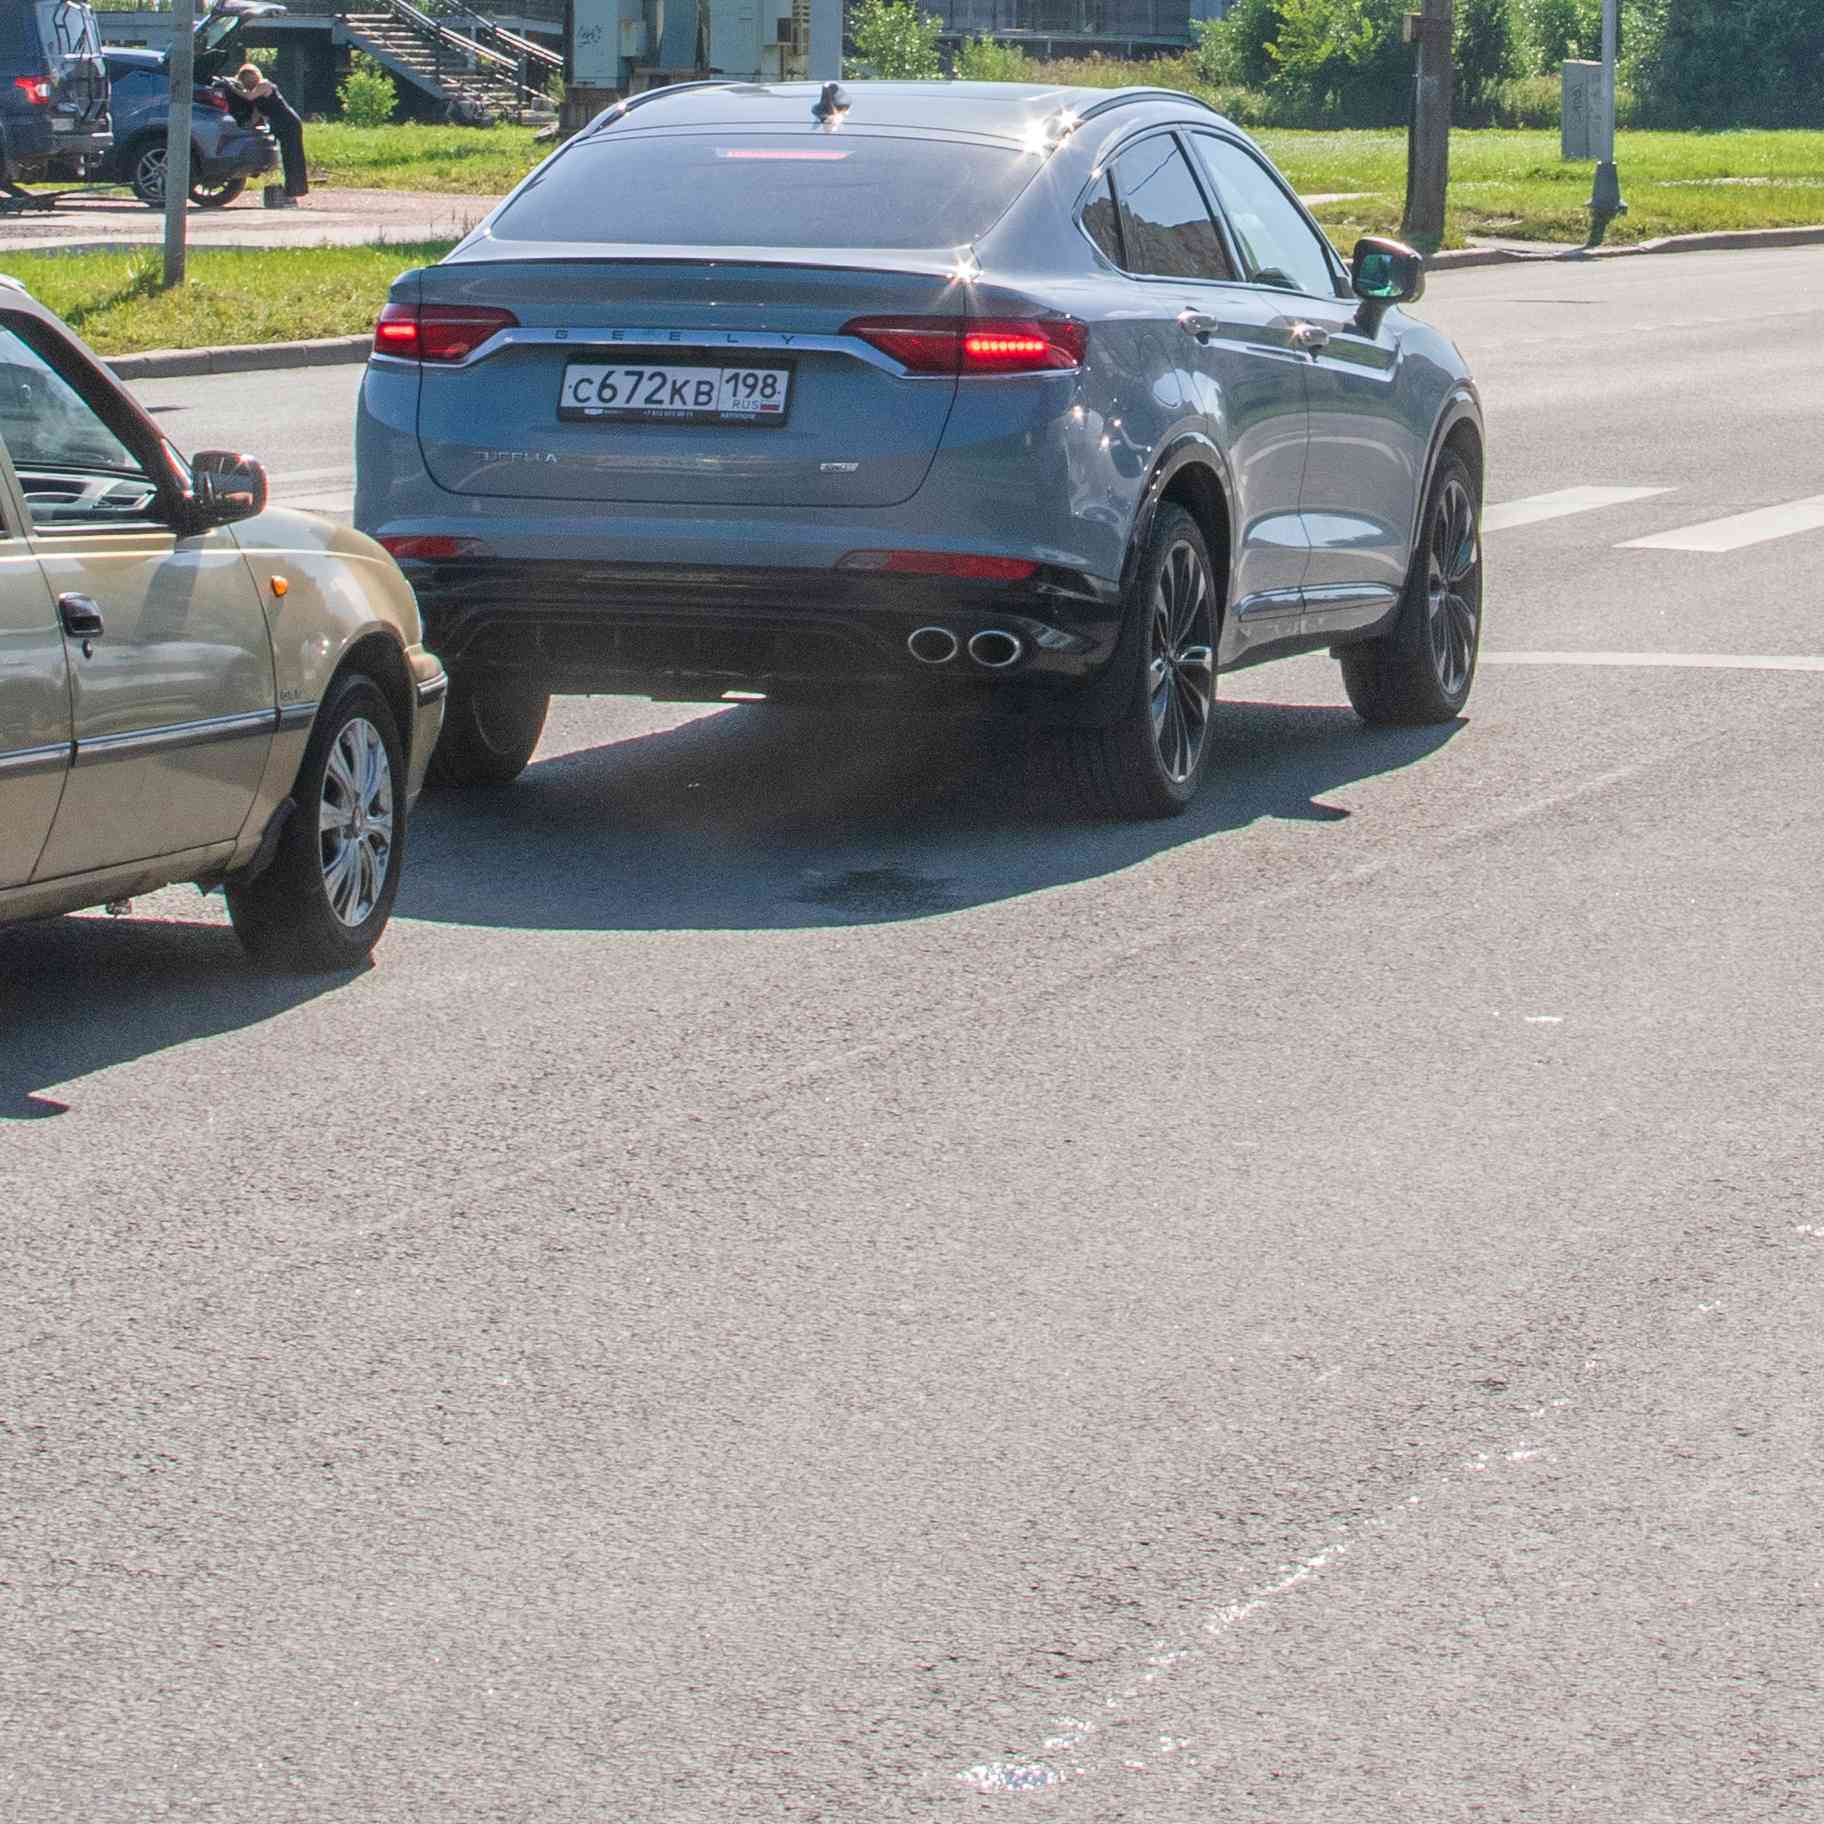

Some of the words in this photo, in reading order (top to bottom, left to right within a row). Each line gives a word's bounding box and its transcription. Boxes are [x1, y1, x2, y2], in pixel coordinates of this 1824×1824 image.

[553, 328, 796, 346] GEELY
[572, 369, 716, 407] С672КВ
[725, 372, 779, 400] 198
[732, 399, 760, 411] RUS
